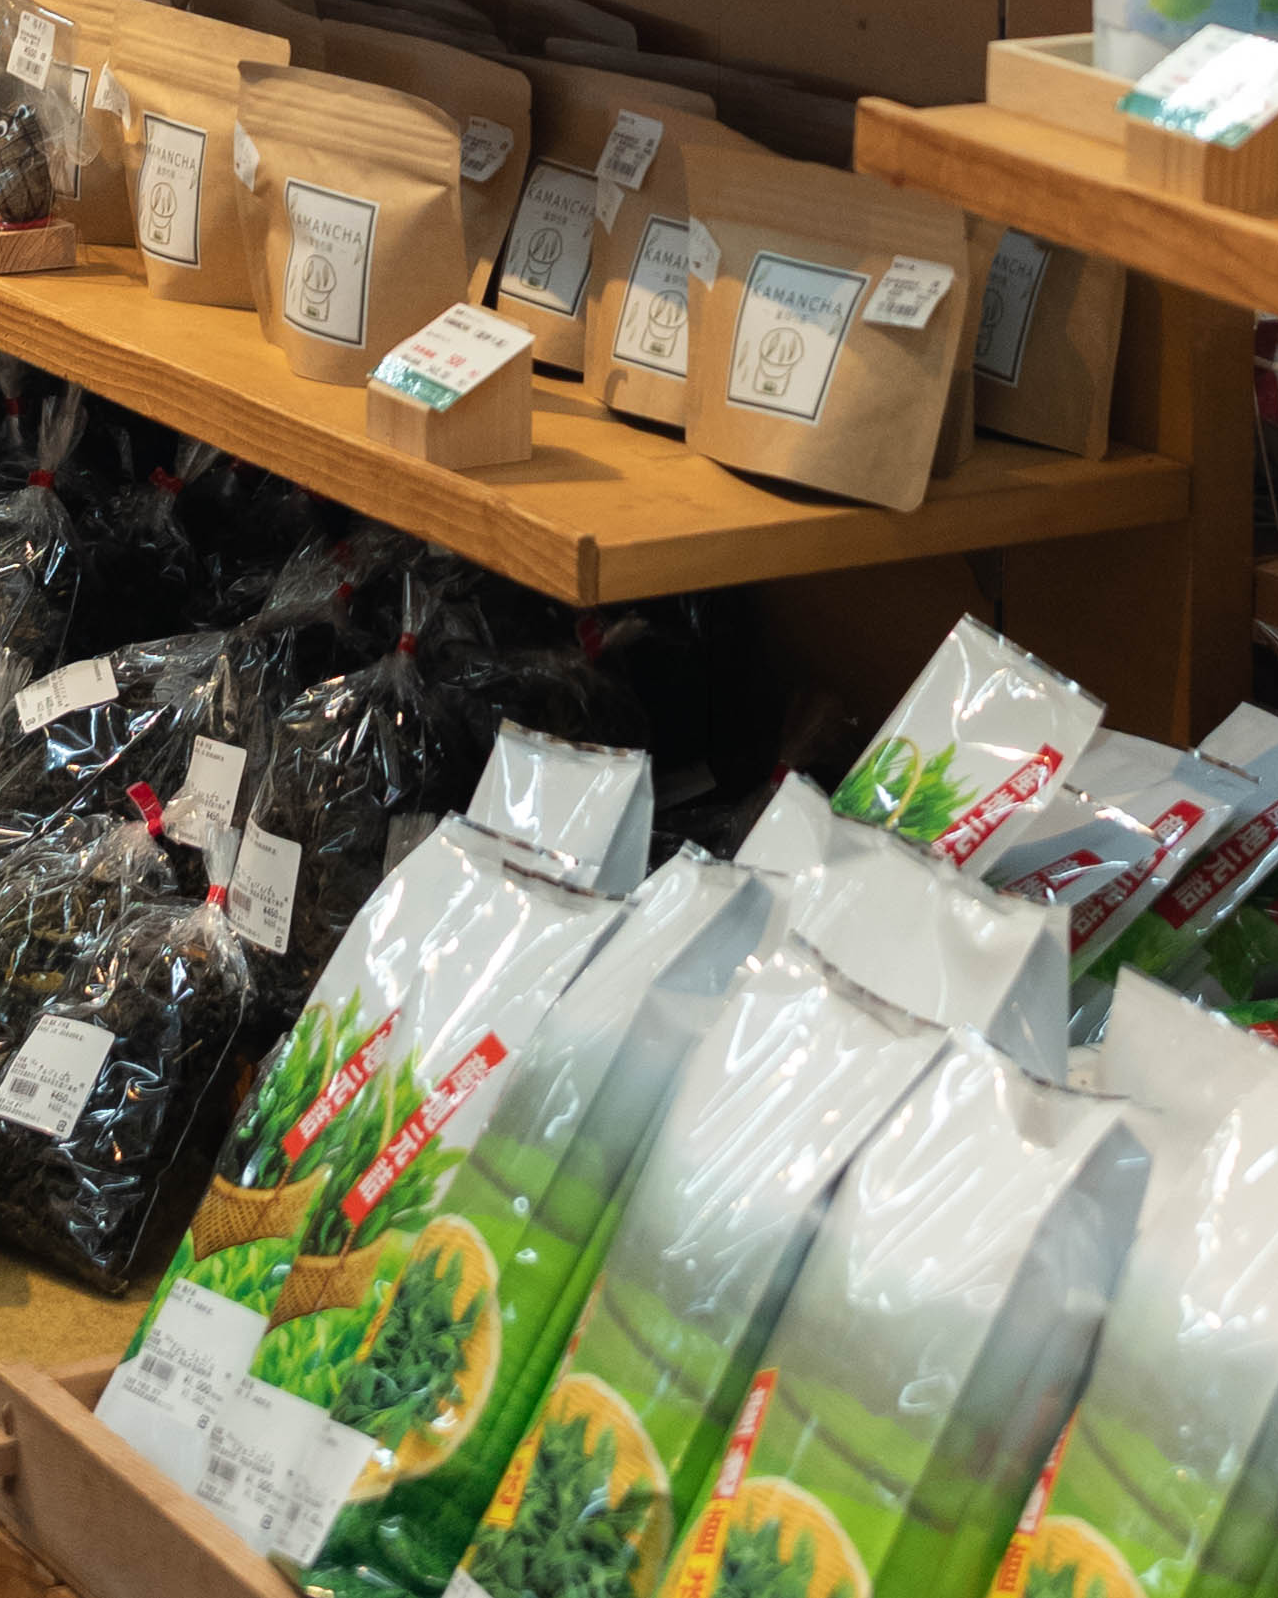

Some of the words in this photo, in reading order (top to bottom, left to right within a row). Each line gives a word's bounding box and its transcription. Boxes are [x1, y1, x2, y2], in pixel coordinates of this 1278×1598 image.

[751, 282, 844, 316] KAMANCHA
[297, 1013, 402, 1141] 地元詰
[357, 1050, 490, 1205] 産地元詰
